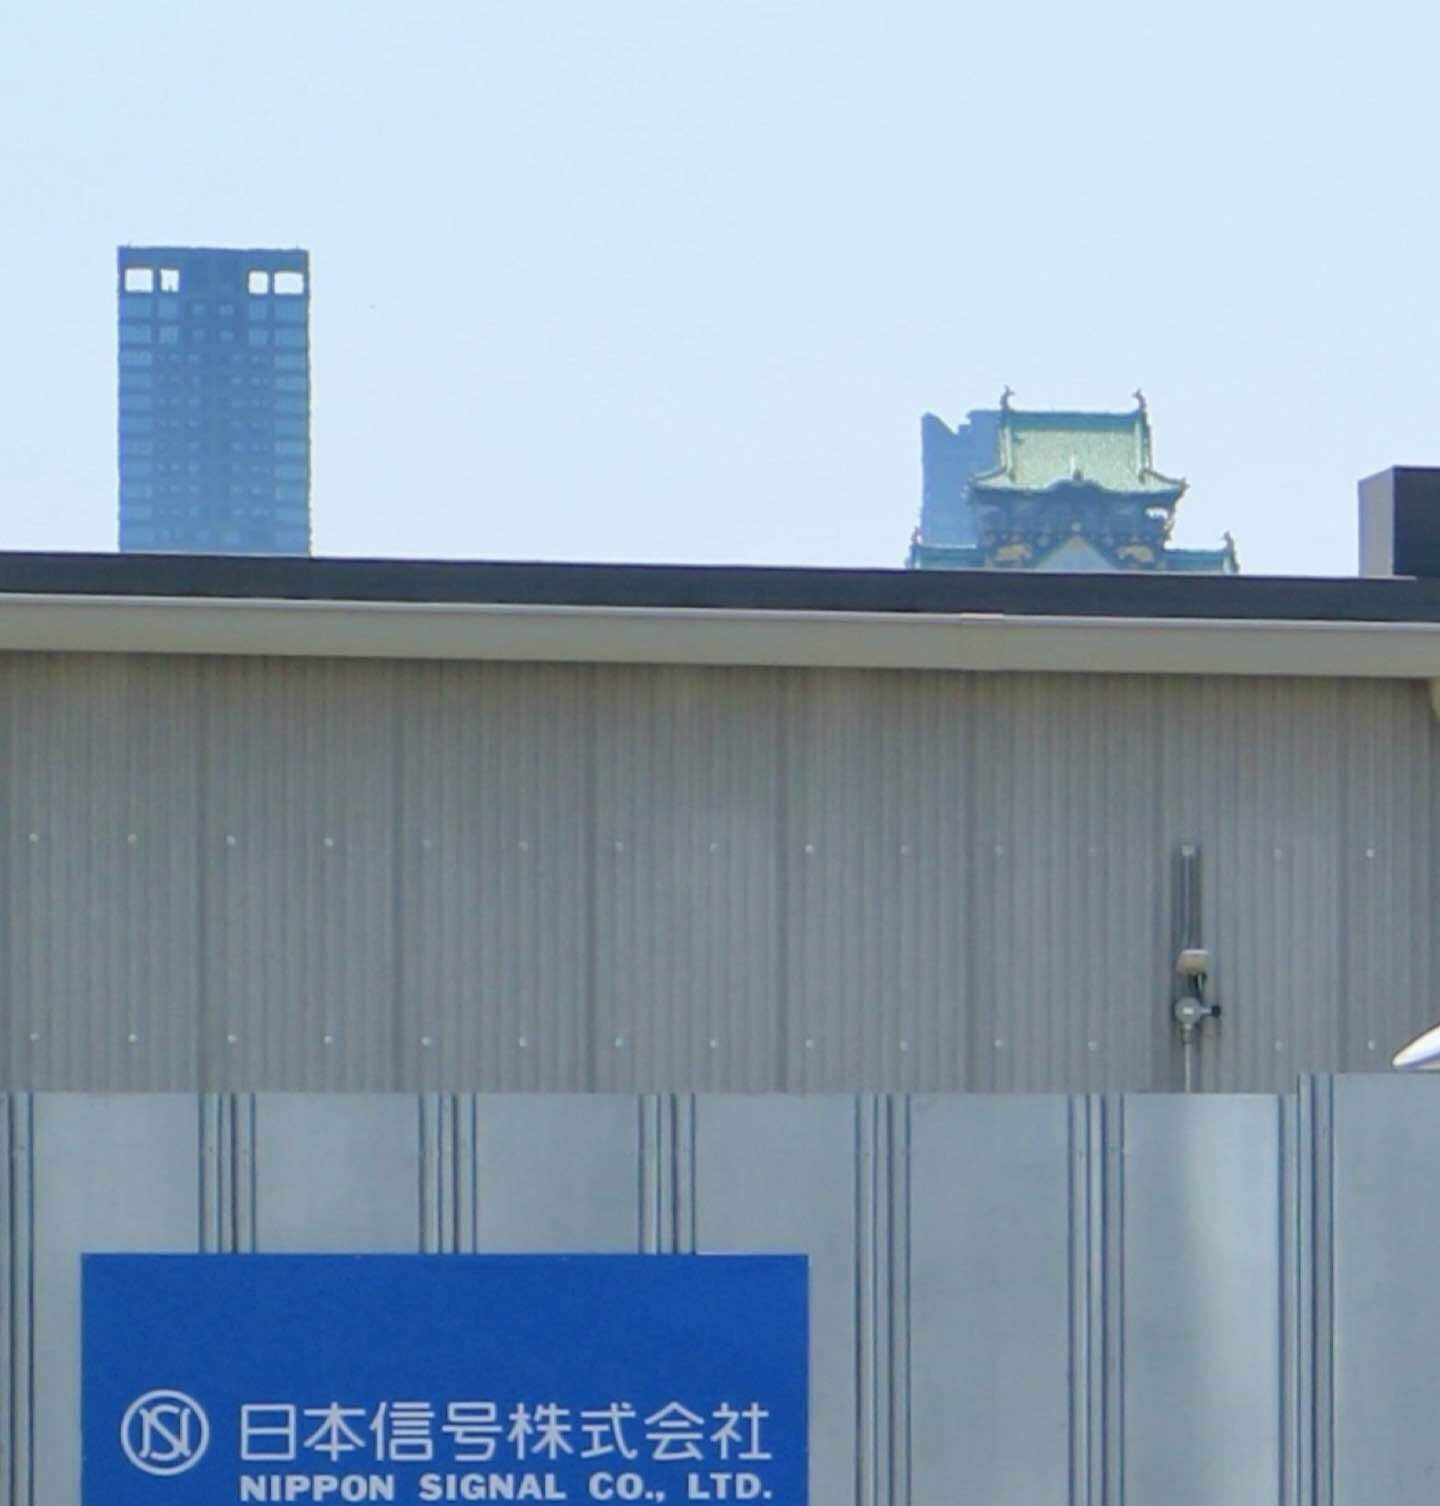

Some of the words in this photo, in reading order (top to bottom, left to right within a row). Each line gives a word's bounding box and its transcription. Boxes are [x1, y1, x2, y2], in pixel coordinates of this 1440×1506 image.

[240, 1401, 772, 1461] 日本信号株式会社
[240, 1474, 394, 1502] NIPPON
[419, 1474, 566, 1501] SIGNAL
[588, 1473, 665, 1503] CO.,
[688, 1473, 772, 1501] LTD.
